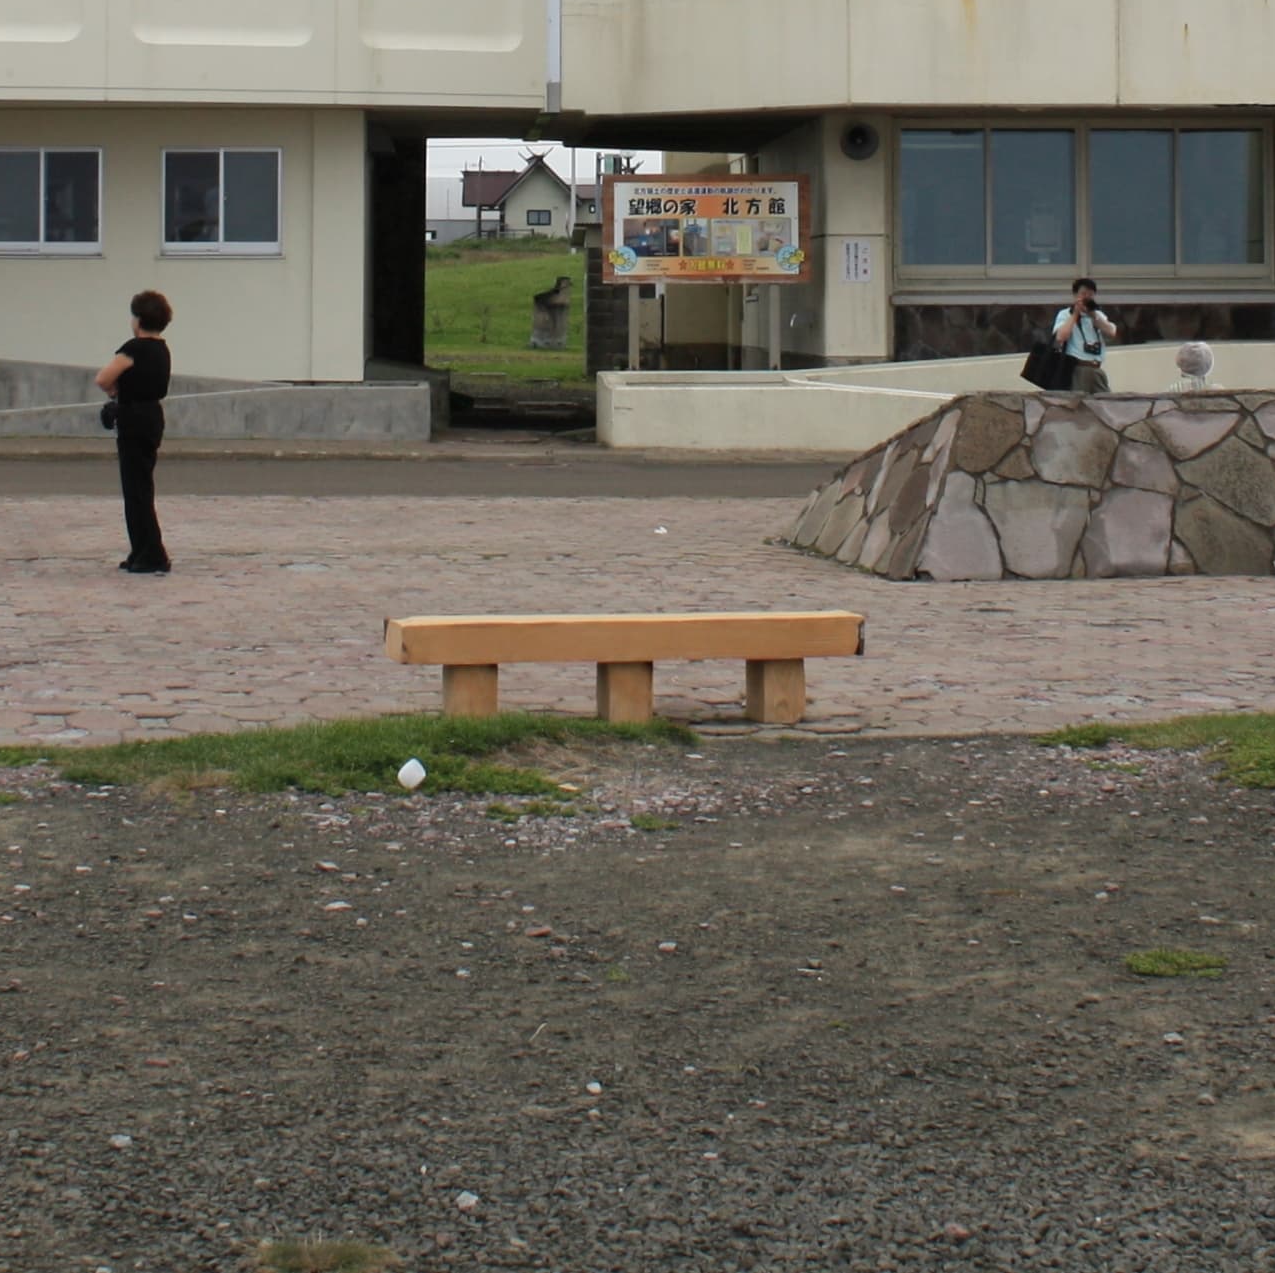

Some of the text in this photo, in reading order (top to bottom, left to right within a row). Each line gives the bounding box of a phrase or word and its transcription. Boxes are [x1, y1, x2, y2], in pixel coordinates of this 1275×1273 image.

[628, 197, 787, 216] 望郷の家 北方館
